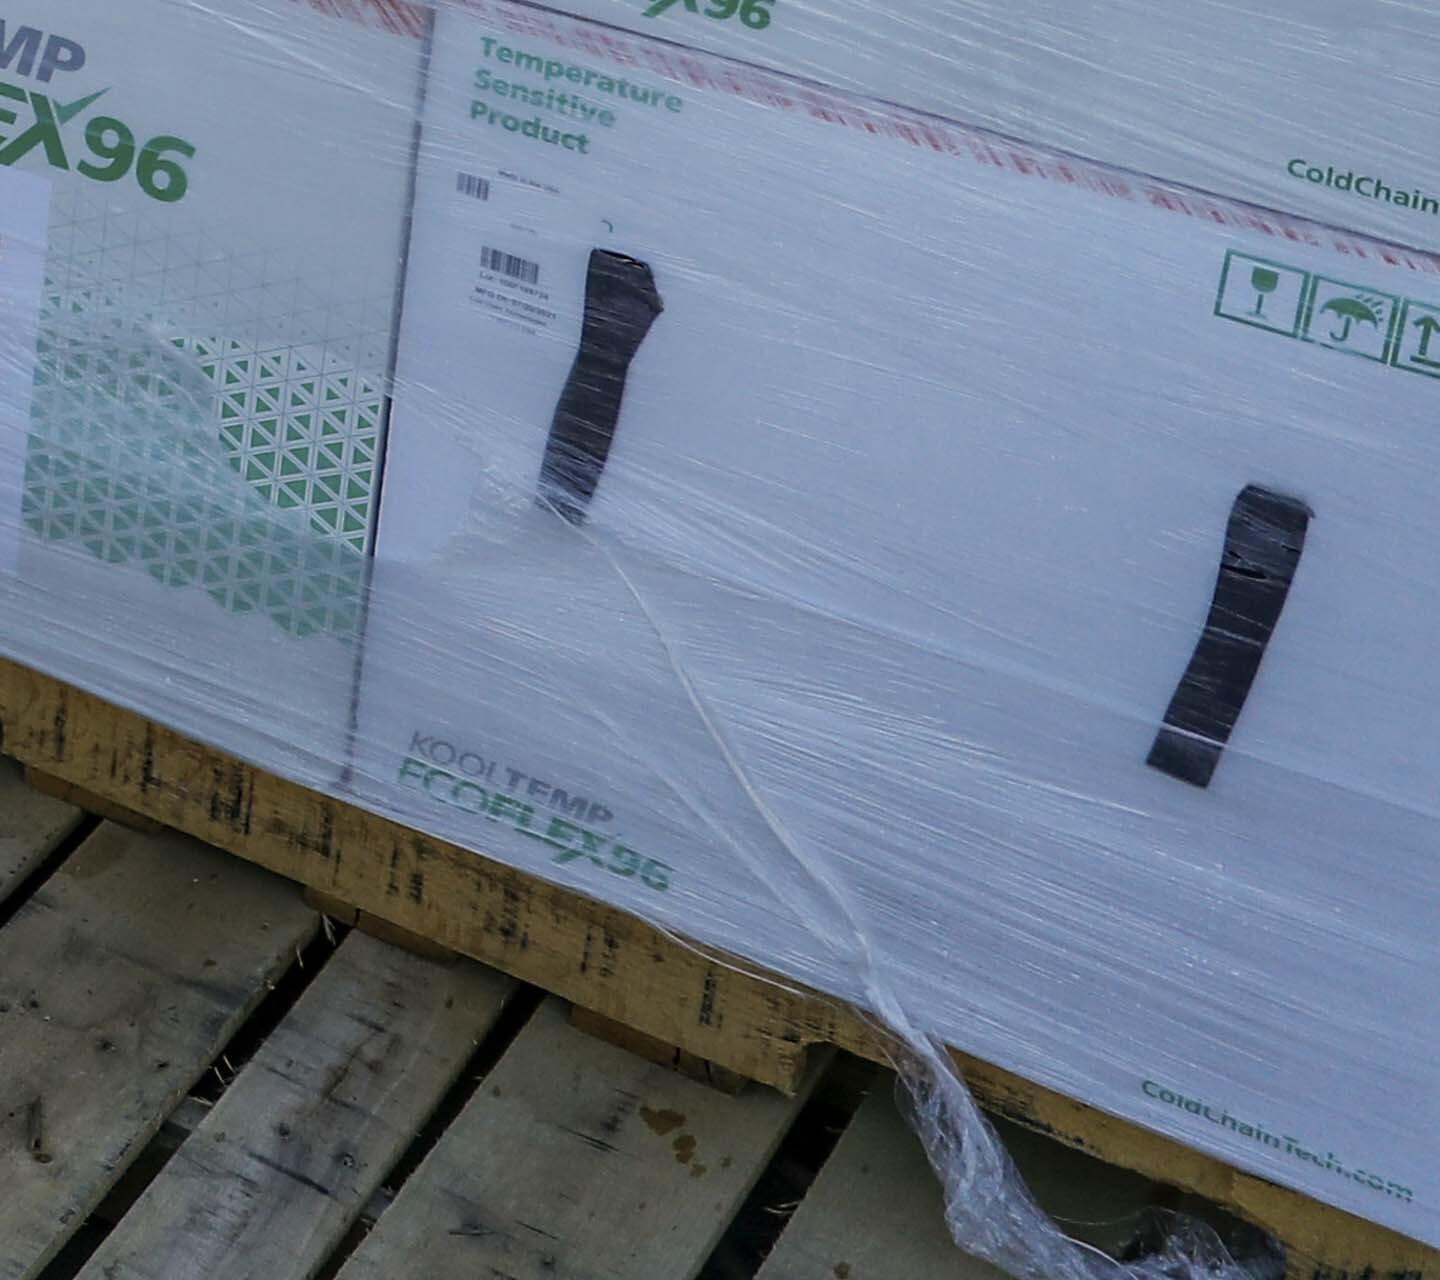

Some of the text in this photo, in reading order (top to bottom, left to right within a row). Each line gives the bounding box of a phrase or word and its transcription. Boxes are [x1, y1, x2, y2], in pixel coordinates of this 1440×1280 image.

[473, 67, 617, 130] Sensitive
[480, 35, 685, 116] Temperature
[468, 100, 592, 156] Product
[408, 730, 616, 823] KOOLTEMP
